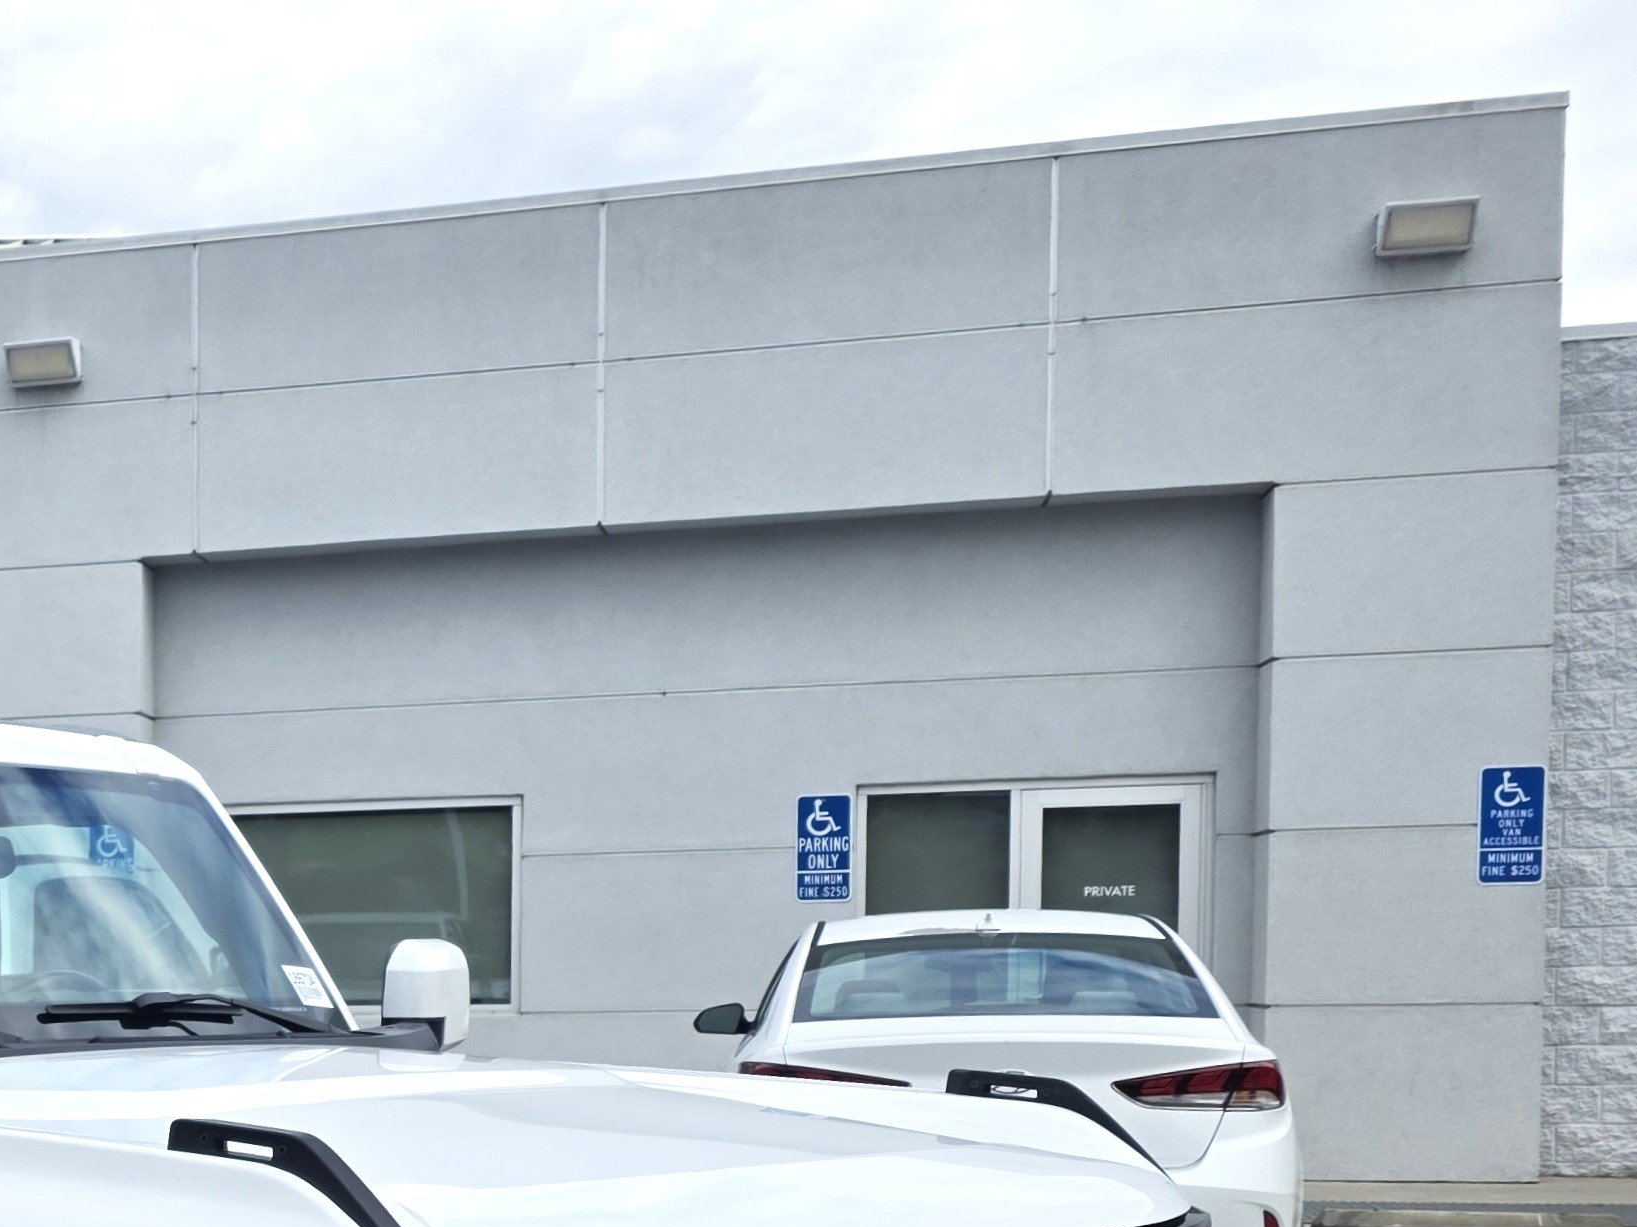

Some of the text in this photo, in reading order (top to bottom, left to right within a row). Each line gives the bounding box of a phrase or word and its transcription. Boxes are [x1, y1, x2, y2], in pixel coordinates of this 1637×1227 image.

[1490, 809, 1534, 818] PARKING
[1499, 819, 1525, 828] ONLY
[1503, 828, 1521, 836] VAN
[799, 836, 849, 852] PARKING
[1483, 836, 1540, 846] ACCESSIBLE
[808, 854, 839, 869] ONLY
[1488, 853, 1534, 863] MINIMUM
[1482, 865, 1539, 876] FINE $250
[805, 874, 843, 885] MINIMUM
[799, 886, 848, 898] FINE $250
[1084, 885, 1136, 897] PRIVATE
